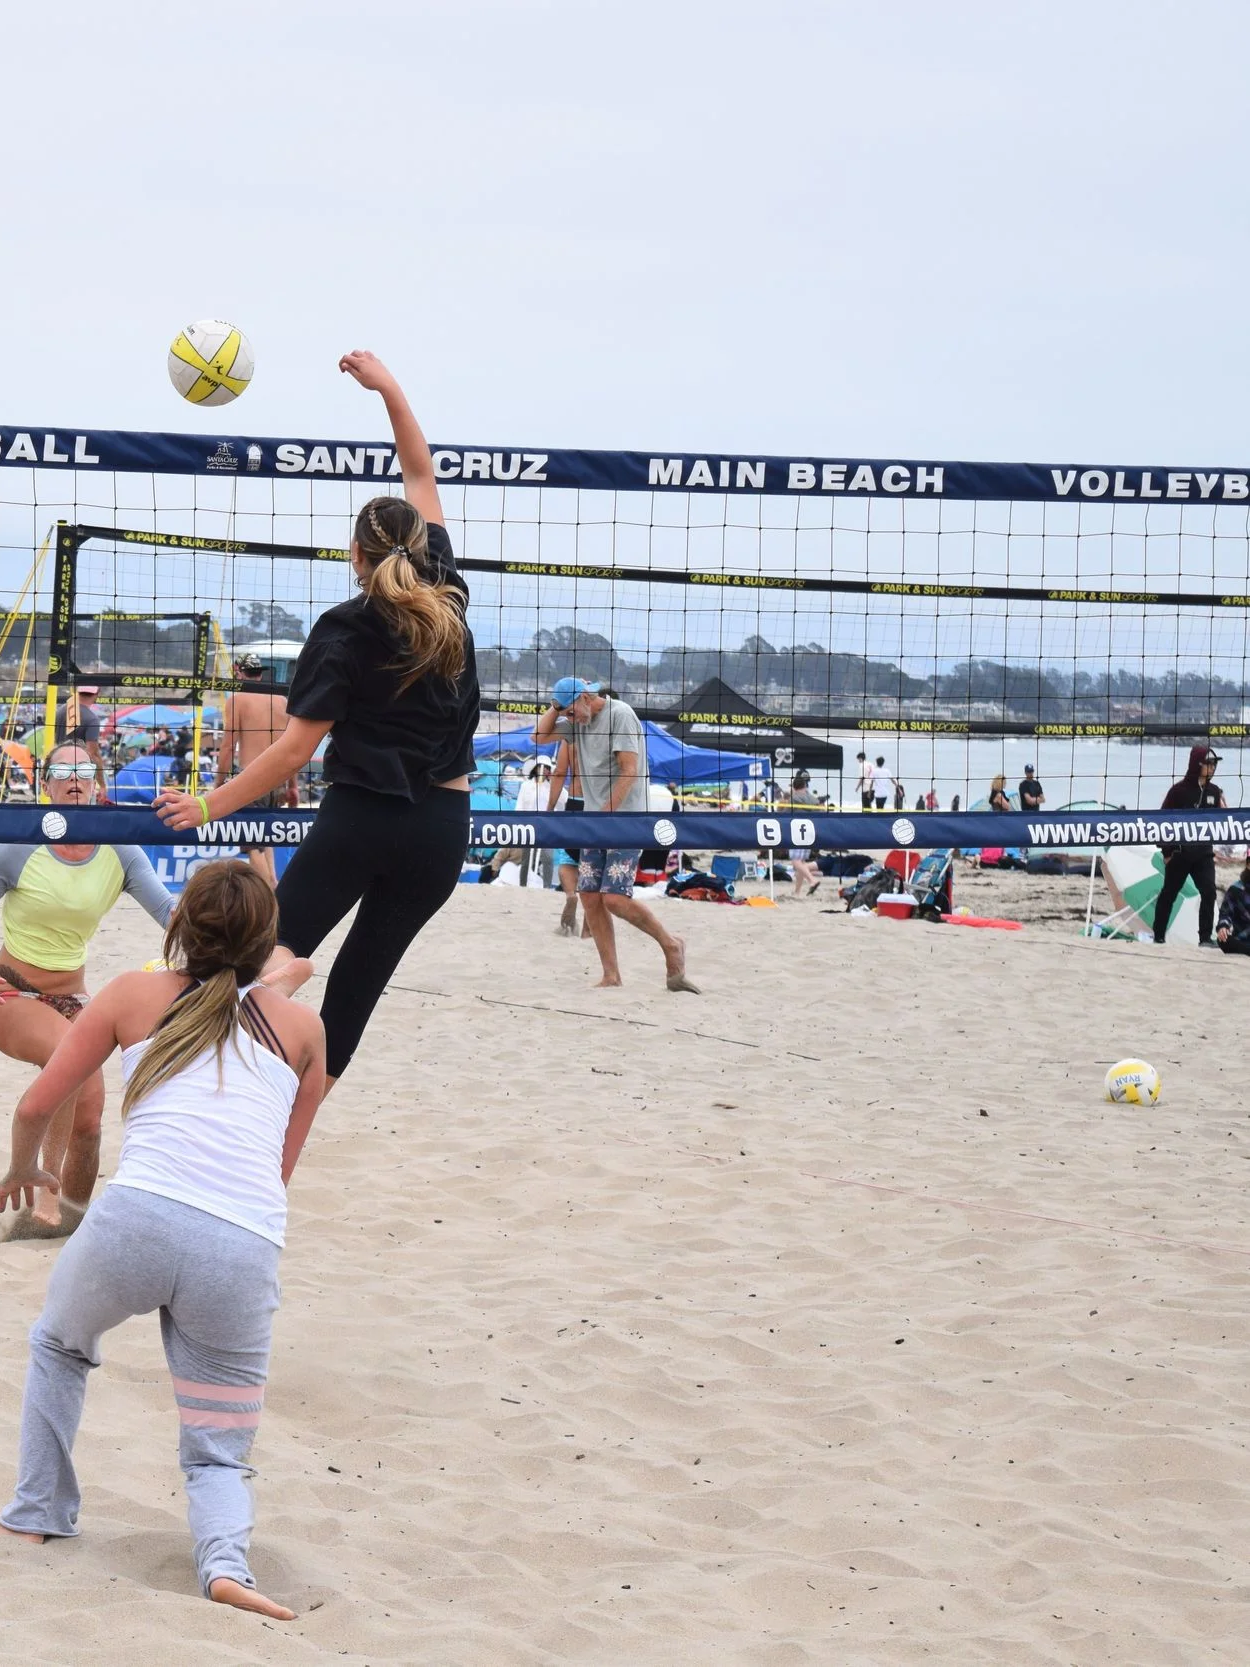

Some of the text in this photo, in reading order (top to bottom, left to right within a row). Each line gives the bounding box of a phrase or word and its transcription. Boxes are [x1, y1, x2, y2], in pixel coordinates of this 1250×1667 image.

[431, 450, 549, 481] CRUZ
[649, 458, 944, 494] MAIN BEACH
[1051, 470, 1249, 499] VOLLEYB
[137, 532, 166, 544] PARK
[169, 536, 179, 545] &
[518, 563, 546, 574] PARK
[549, 565, 557, 575] &
[702, 574, 731, 585] PARK
[733, 576, 742, 585] &
[883, 583, 911, 594] PARK
[912, 585, 921, 594] &
[1060, 591, 1088, 601] PARK
[1089, 592, 1097, 601] &
[135, 676, 163, 686] PARK
[166, 677, 175, 687] &
[509, 703, 537, 714] PARK
[691, 713, 719, 723] PARK
[721, 715, 729, 724] &
[870, 720, 897, 730] PARK
[899, 721, 908, 731] &
[1045, 725, 1073, 734] PARK
[1076, 726, 1084, 735] &
[1220, 725, 1247, 735] PARK
